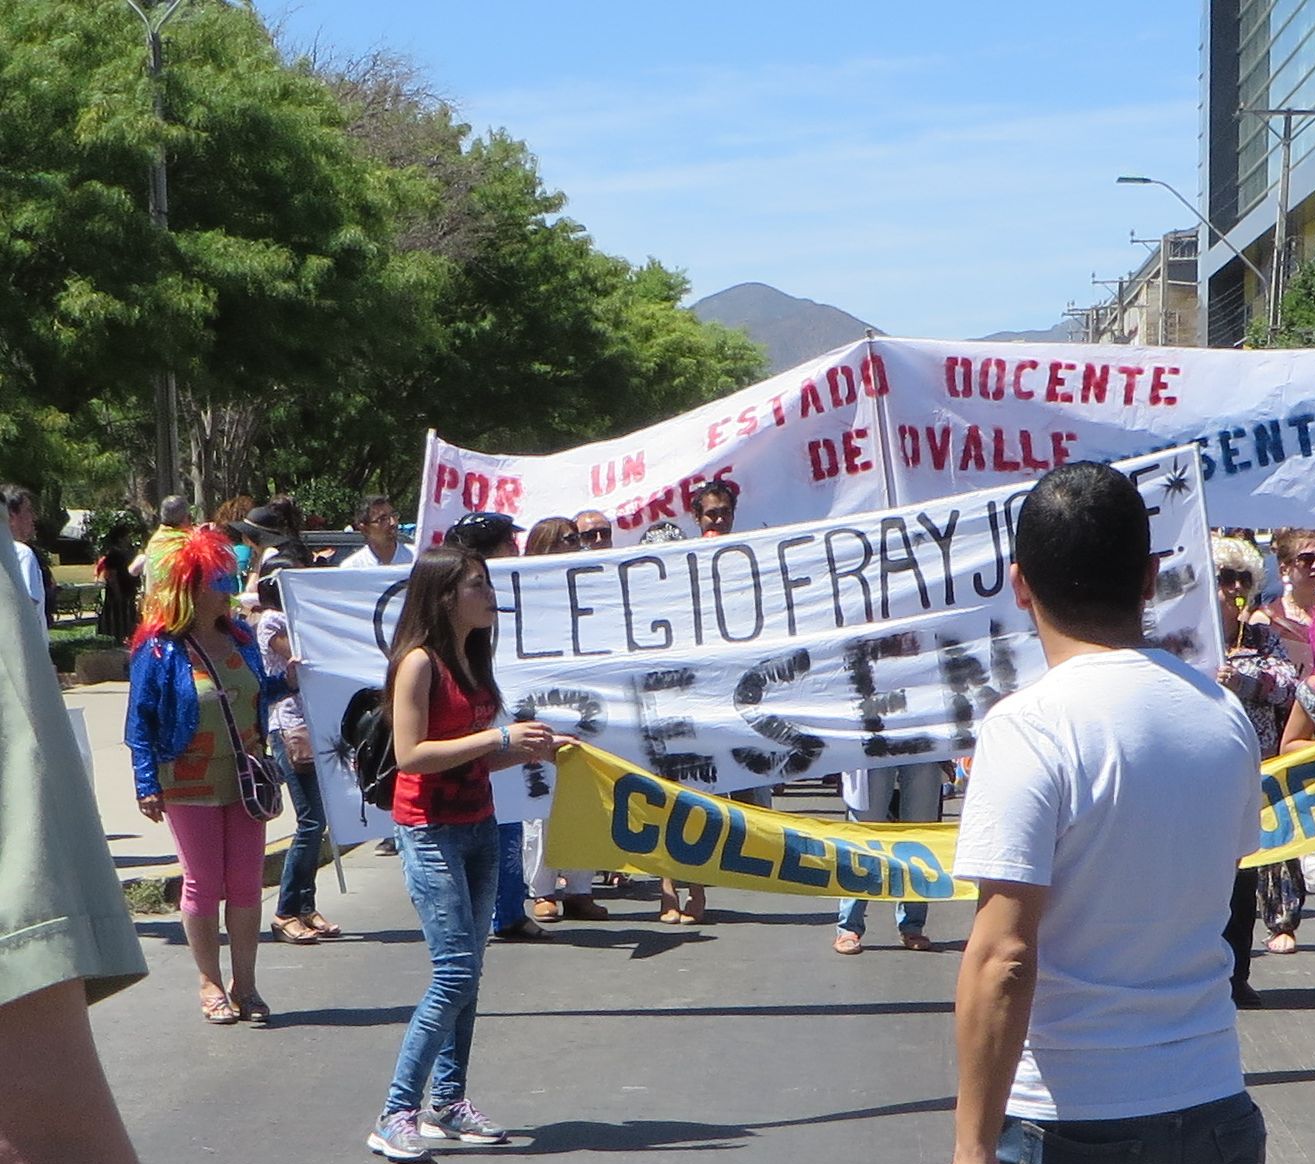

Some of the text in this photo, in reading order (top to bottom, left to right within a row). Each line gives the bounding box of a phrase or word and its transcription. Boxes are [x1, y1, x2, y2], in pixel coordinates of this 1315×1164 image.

[434, 463, 523, 514] POR
[590, 449, 646, 497] UN
[706, 353, 891, 450] ESTADO
[945, 356, 1181, 406] DOCENTE
[808, 428, 873, 482] DE
[898, 424, 1078, 474] OVALLE
[372, 543, 762, 662] CLEGIO
